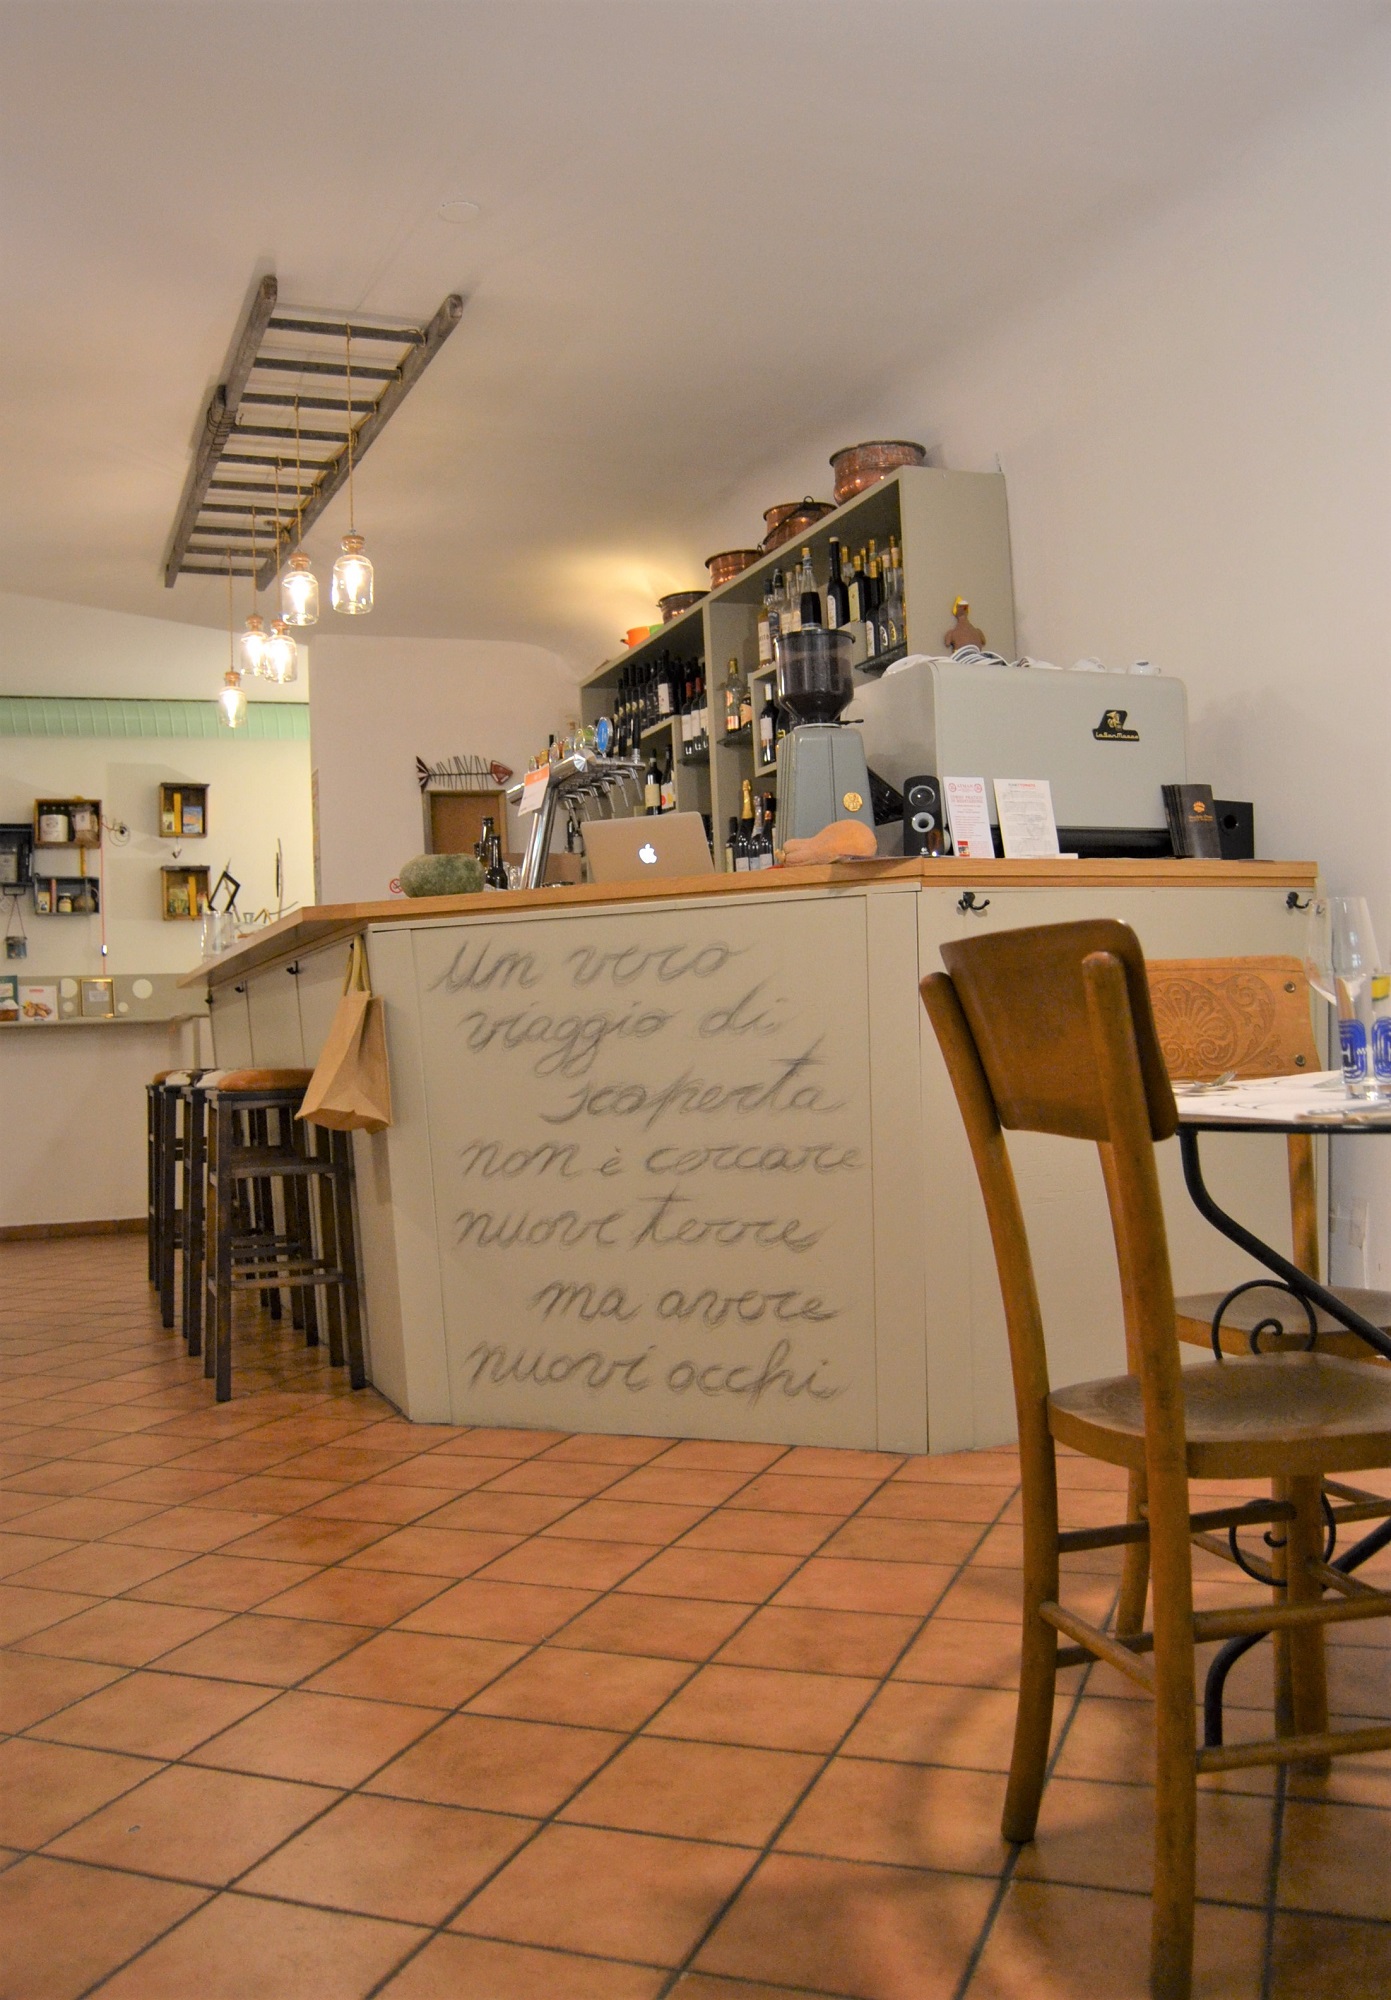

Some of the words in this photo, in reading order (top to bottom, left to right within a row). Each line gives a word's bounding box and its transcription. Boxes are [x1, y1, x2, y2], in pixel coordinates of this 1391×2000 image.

[430, 939, 542, 991] Un
[563, 941, 753, 989] vero
[457, 1000, 680, 1078] viaggio
[699, 968, 792, 1037] di
[539, 1033, 847, 1134] scoperta
[460, 1139, 580, 1178] non
[599, 1147, 623, 1176] è
[644, 1141, 864, 1176] cercare
[455, 1207, 621, 1249] nuove
[634, 1186, 822, 1251] terre
[537, 1280, 641, 1322] ma
[657, 1288, 840, 1326] avere
[467, 1342, 654, 1392] nuovi
[666, 1339, 848, 1405] occhi
